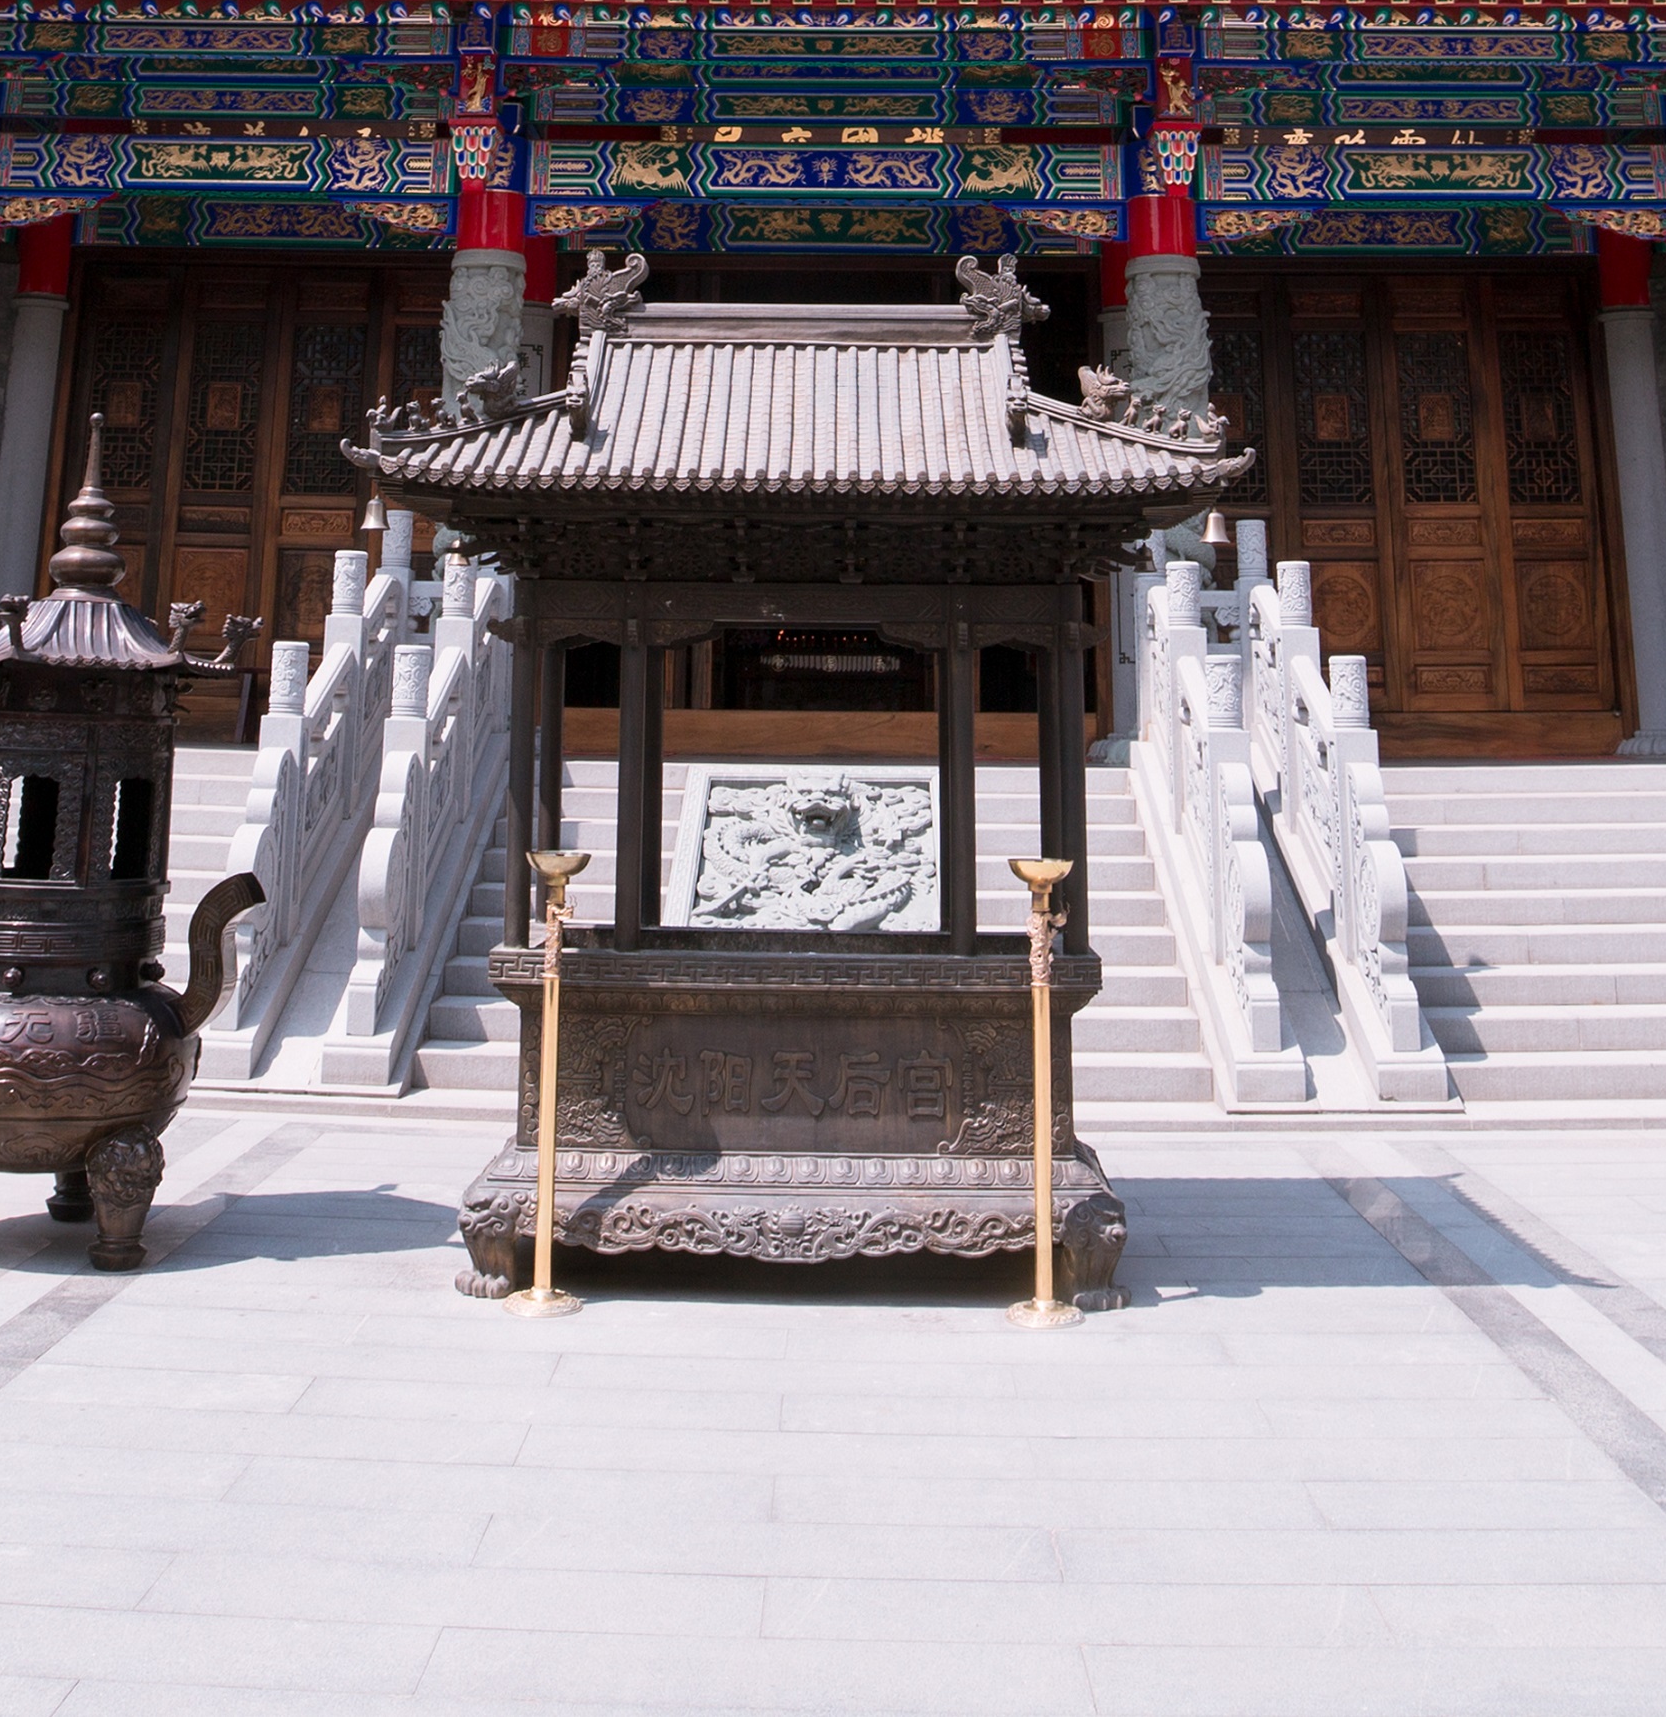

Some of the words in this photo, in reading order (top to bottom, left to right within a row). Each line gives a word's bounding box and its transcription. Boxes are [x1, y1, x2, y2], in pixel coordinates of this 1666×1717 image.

[632, 1047, 953, 1116] 沈阳天后宫
